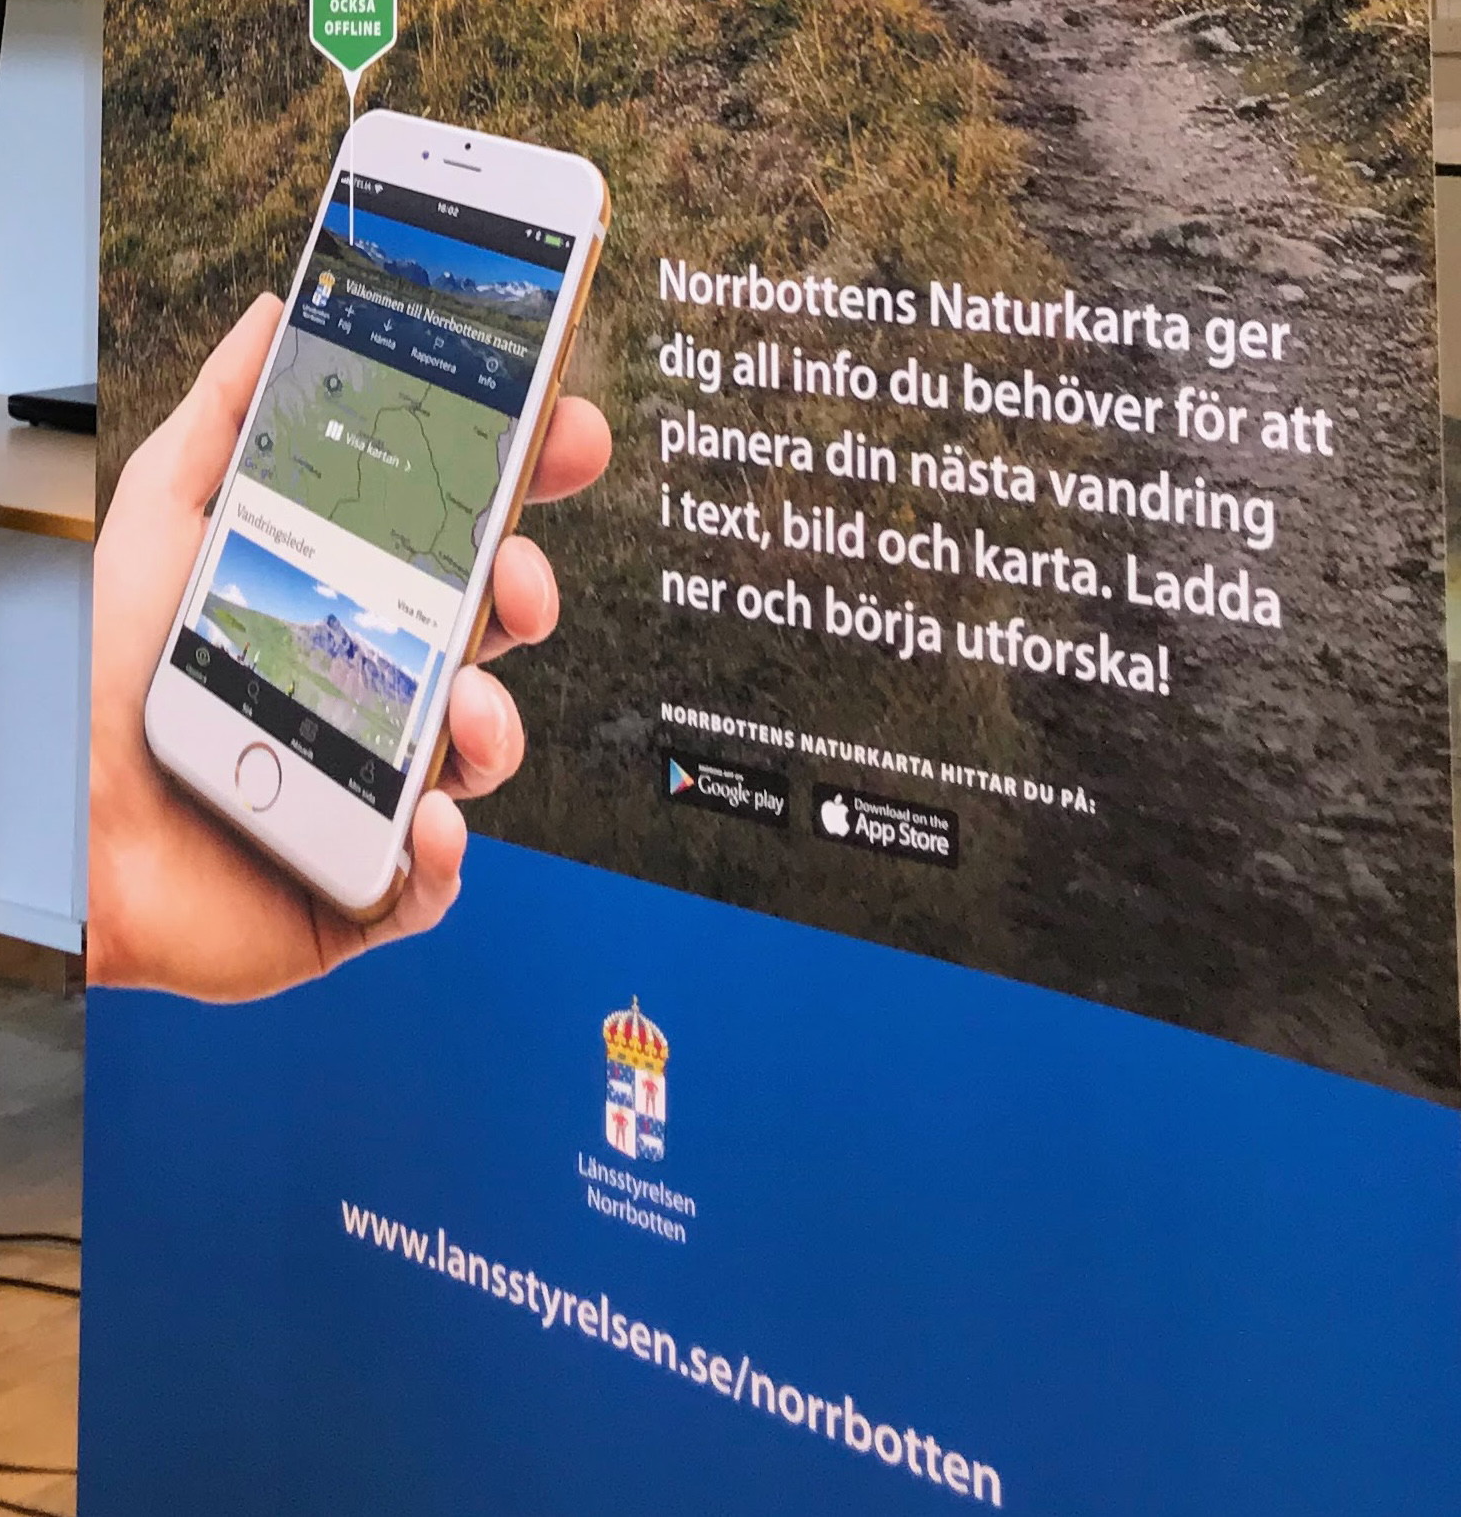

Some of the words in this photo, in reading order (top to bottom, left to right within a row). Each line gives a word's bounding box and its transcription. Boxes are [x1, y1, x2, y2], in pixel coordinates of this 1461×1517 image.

[324, 20, 381, 36] OFFLINE
[346, 278, 405, 313] Välkommen
[406, 302, 423, 320] till
[423, 307, 492, 345] Norrbottens
[492, 336, 529, 358] natur
[658, 258, 916, 326] Norrbottens
[929, 281, 1190, 351] Naturkarta
[1205, 316, 1292, 370] ger
[658, 334, 722, 380] dig
[732, 342, 779, 388] all
[793, 348, 877, 401] info
[889, 358, 949, 409] du
[964, 364, 1162, 433] behöver
[1175, 386, 1247, 444] för
[1260, 406, 1334, 456] att
[660, 410, 813, 472] planera
[825, 431, 896, 482] din
[911, 445, 1035, 503] nästa
[1049, 470, 1276, 550] vandring
[237, 502, 317, 559] Vandringsleder
[660, 484, 670, 527] i
[682, 494, 771, 550] text,
[783, 500, 865, 559] bild
[878, 523, 960, 575] och
[975, 530, 1112, 600] karta.
[1126, 555, 1282, 629] Ladda
[661, 570, 727, 612] ner
[736, 580, 812, 630] och
[826, 585, 942, 659] börja
[956, 617, 1171, 696] utforska!
[660, 702, 795, 749] NORRBOTTENS
[800, 732, 934, 780] NATURKARTA
[940, 762, 1017, 798] HITTAR
[1023, 779, 1054, 805] DU
[1060, 785, 1096, 815] PÅ:
[697, 774, 751, 808] Google
[754, 788, 784, 816] play
[854, 797, 911, 822] Download
[912, 812, 928, 826] on
[929, 814, 949, 831] the
[855, 812, 896, 847] App
[898, 822, 950, 856] Store
[578, 1150, 696, 1219] Länsstyrelsen
[587, 1184, 687, 1245] Norrbotten
[341, 1198, 1003, 1509] www.lansstyrelsen.se/norrbotten
